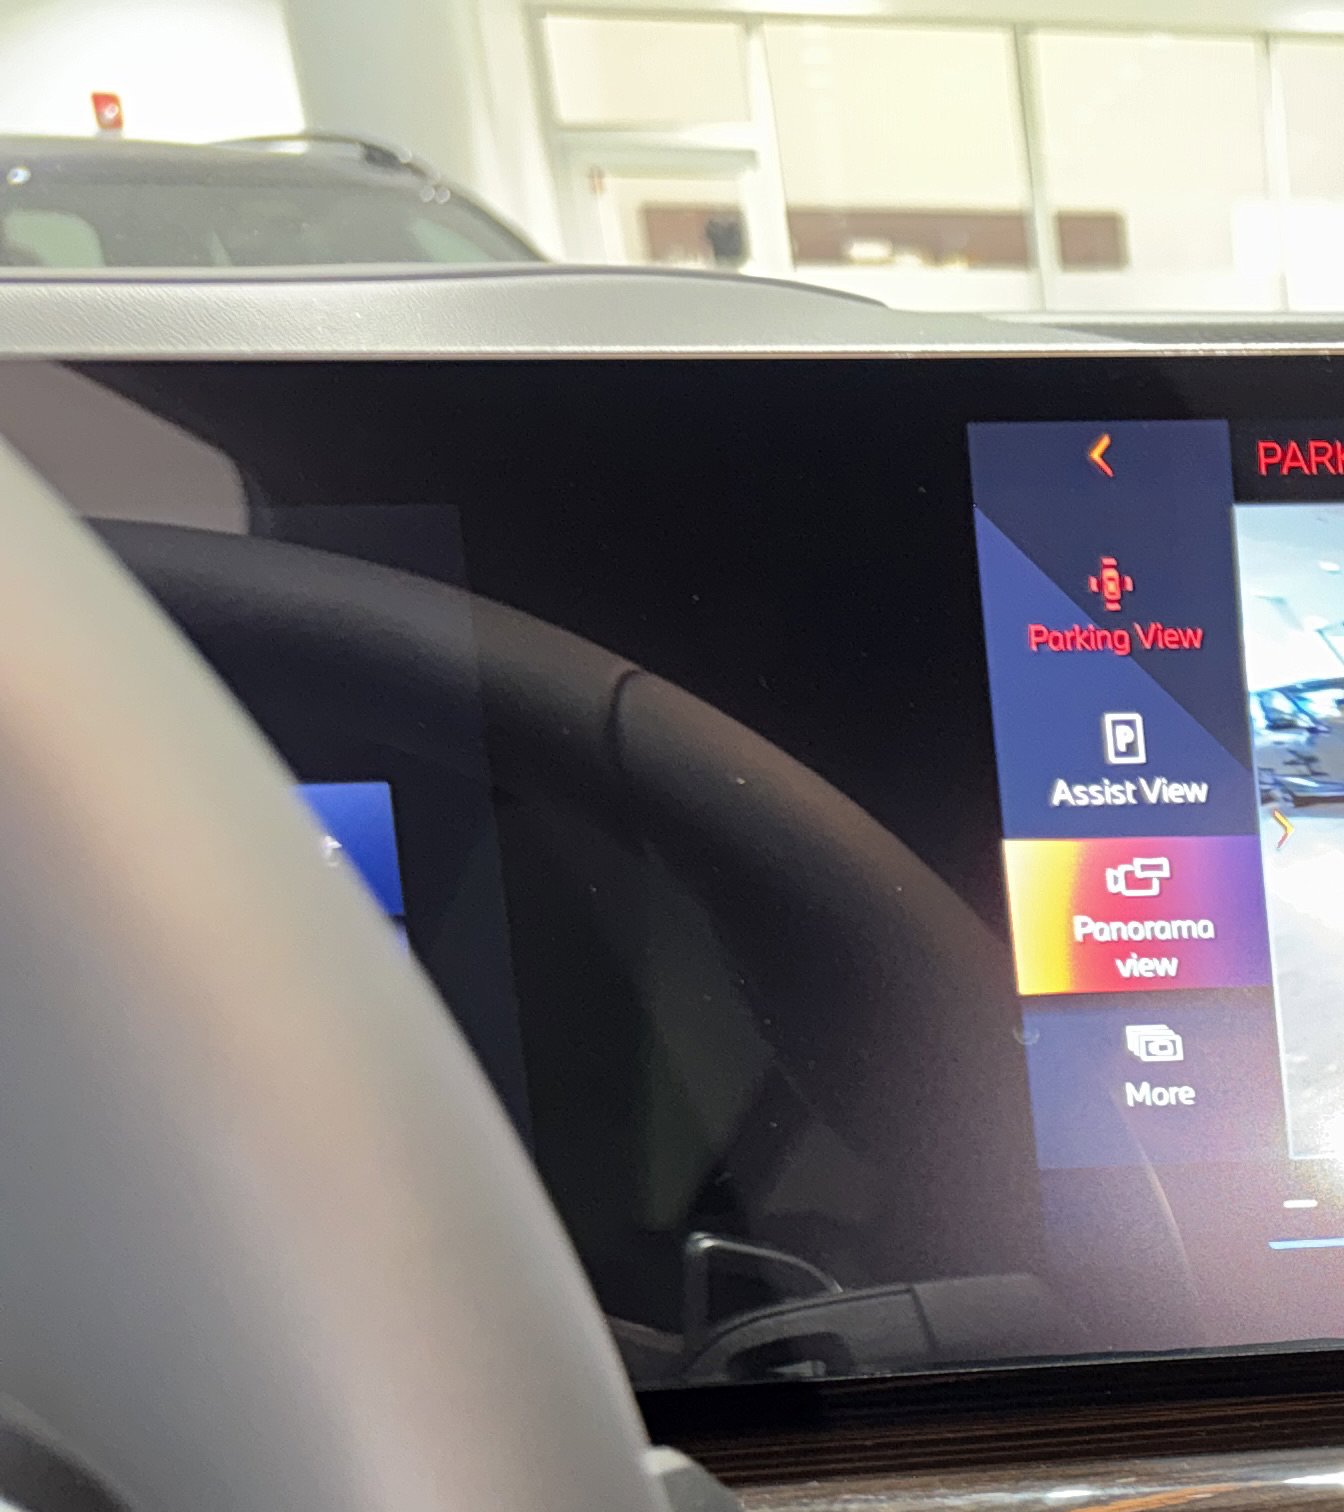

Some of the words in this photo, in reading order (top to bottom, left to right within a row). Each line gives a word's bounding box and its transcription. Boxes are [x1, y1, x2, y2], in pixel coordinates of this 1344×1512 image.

[1028, 622, 1130, 655] Parking
[1137, 622, 1203, 650] View
[1050, 778, 1136, 808] Assist
[1141, 777, 1208, 804] View
[1073, 914, 1215, 943] Panorama
[1116, 952, 1179, 979] view
[1125, 1080, 1196, 1107] More
